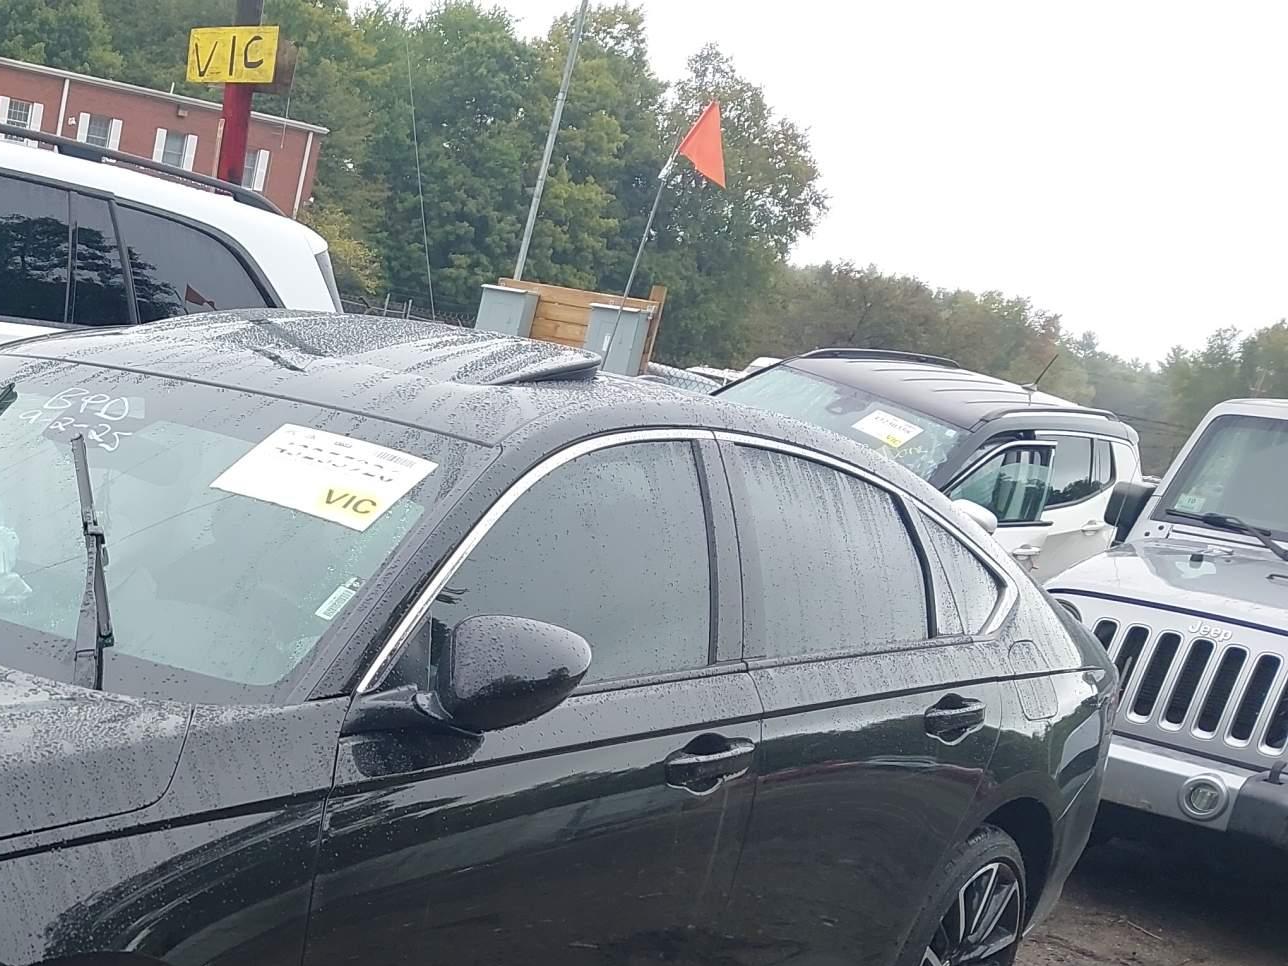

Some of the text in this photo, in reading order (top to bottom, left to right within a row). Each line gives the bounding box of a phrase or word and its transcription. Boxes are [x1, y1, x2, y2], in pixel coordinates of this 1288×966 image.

[194, 35, 264, 77] VIC
[324, 488, 378, 515] VIC
[1188, 620, 1233, 642] Jeep
